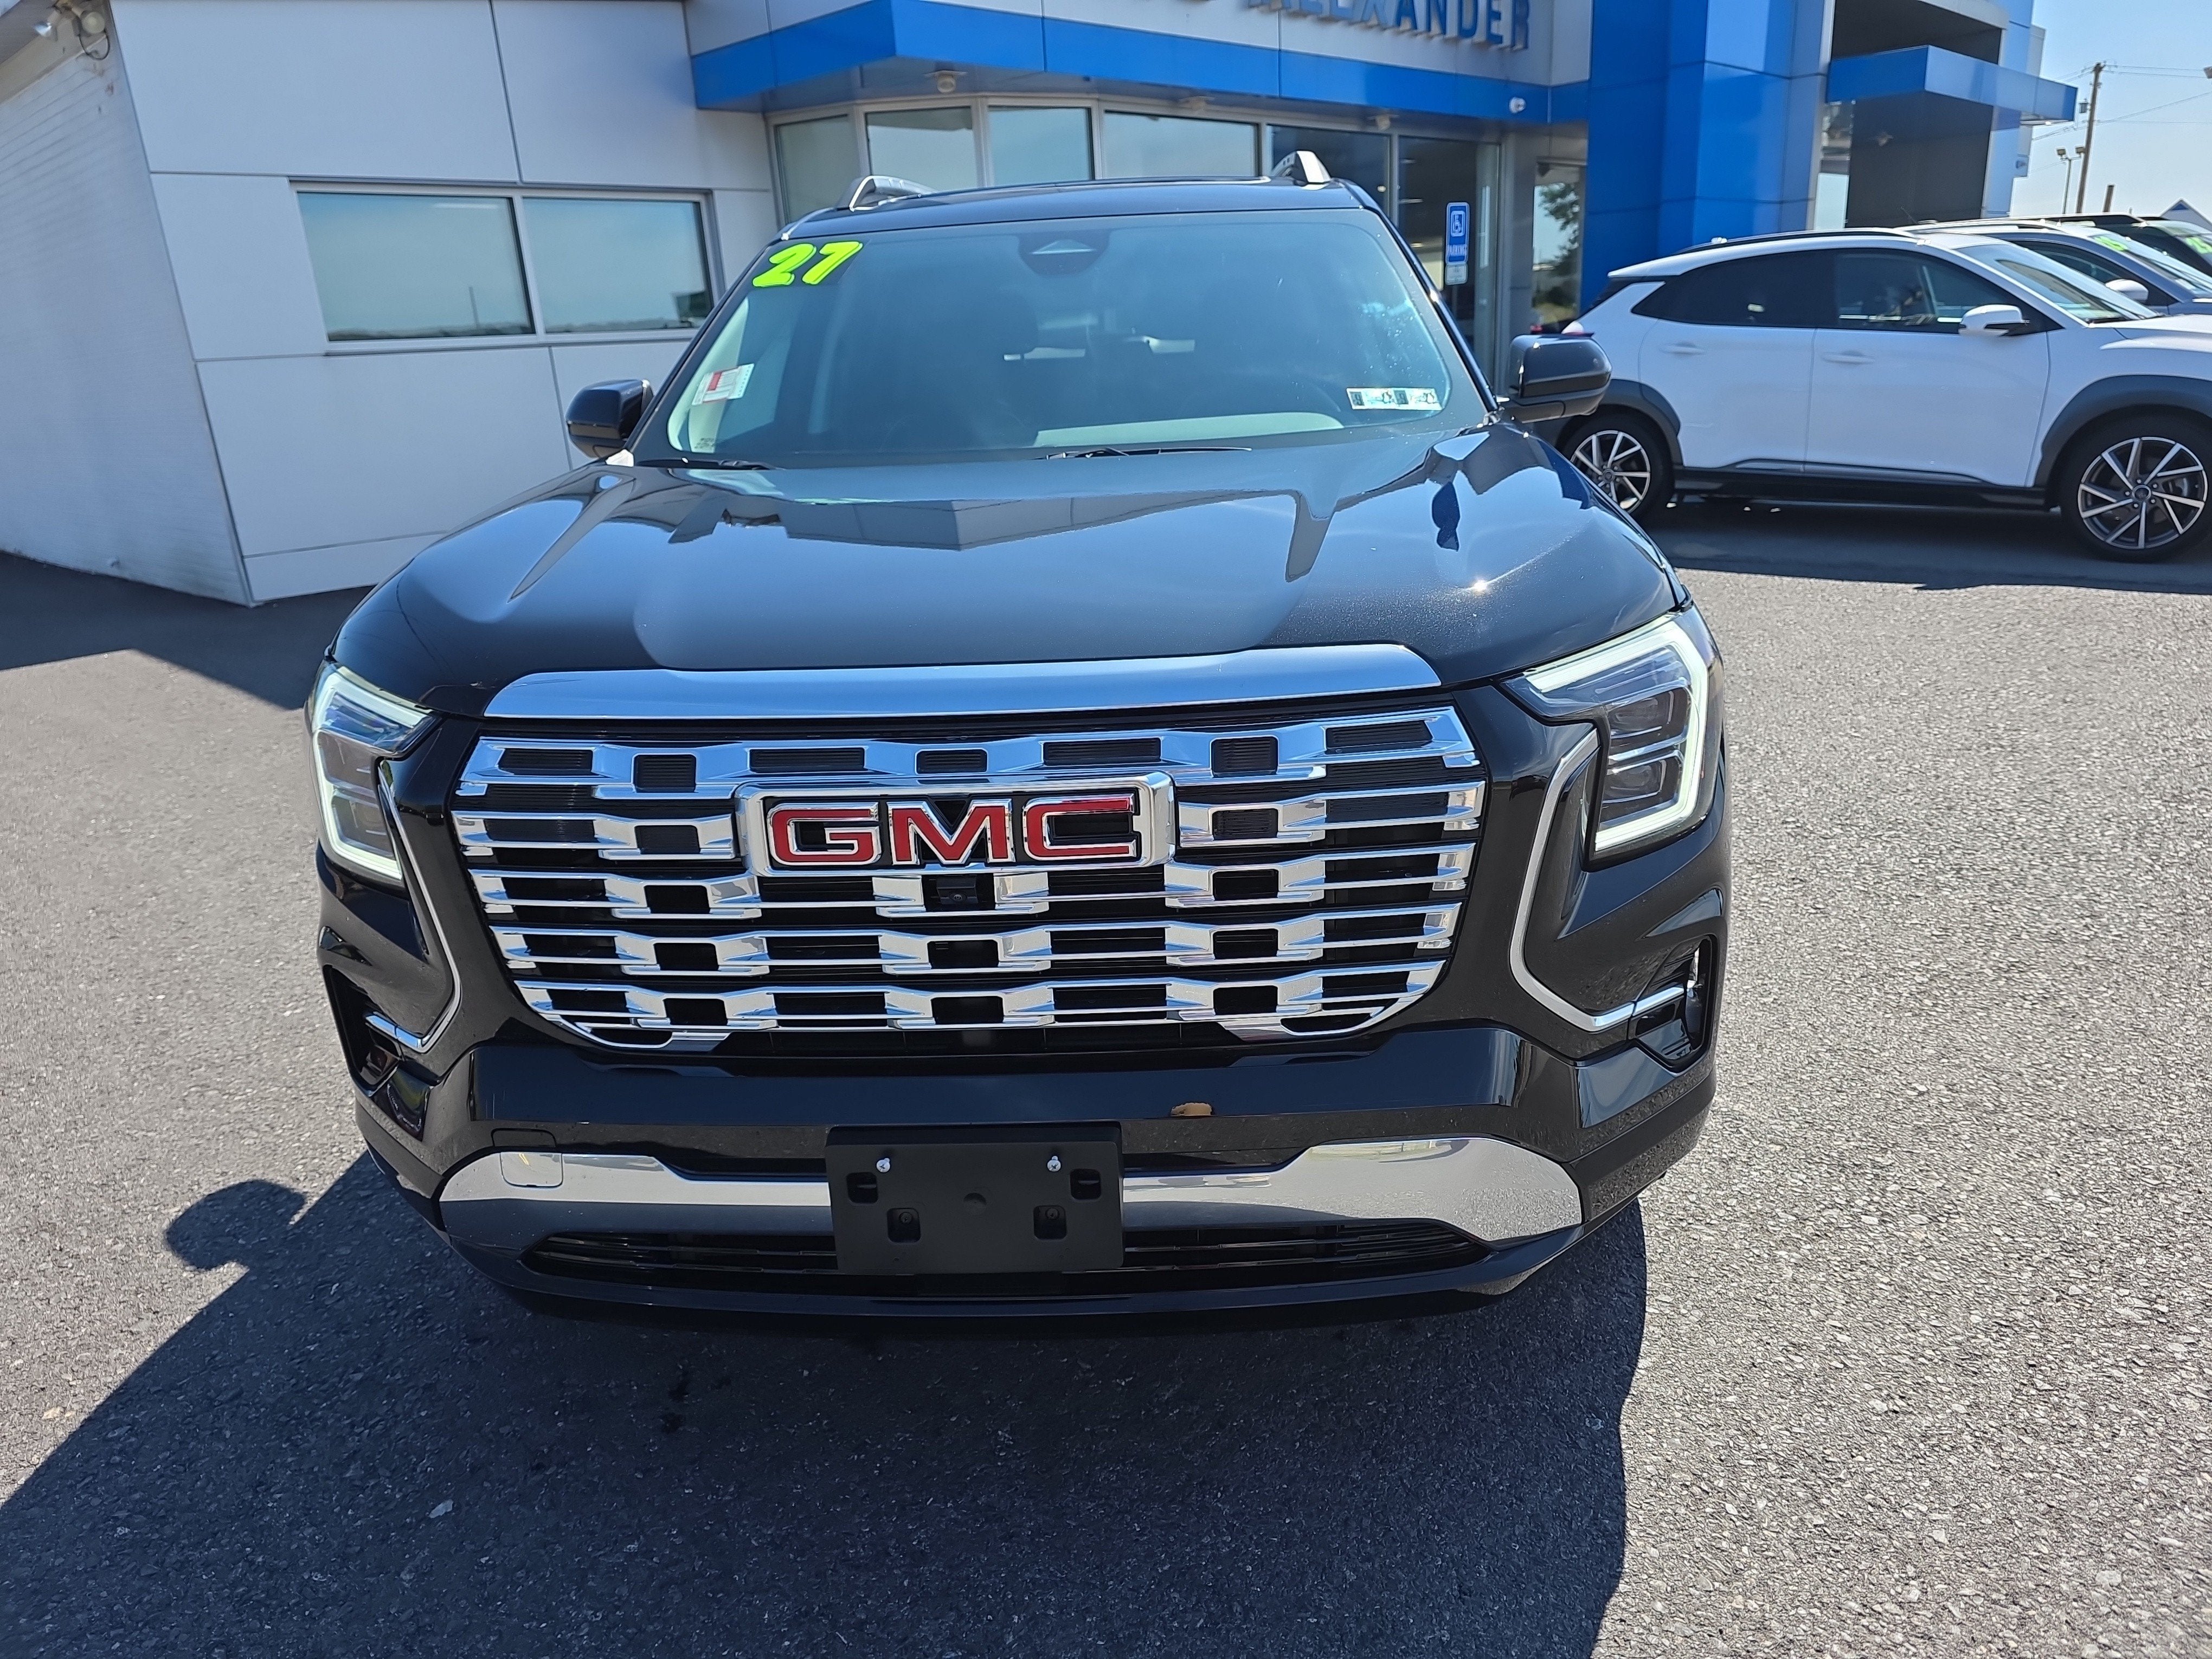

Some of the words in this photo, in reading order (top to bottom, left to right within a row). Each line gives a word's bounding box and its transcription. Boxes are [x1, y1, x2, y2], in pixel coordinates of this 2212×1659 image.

[1248, 0, 1529, 49] ANDER
[751, 241, 863, 288] 27
[767, 794, 1136, 865] GMC
